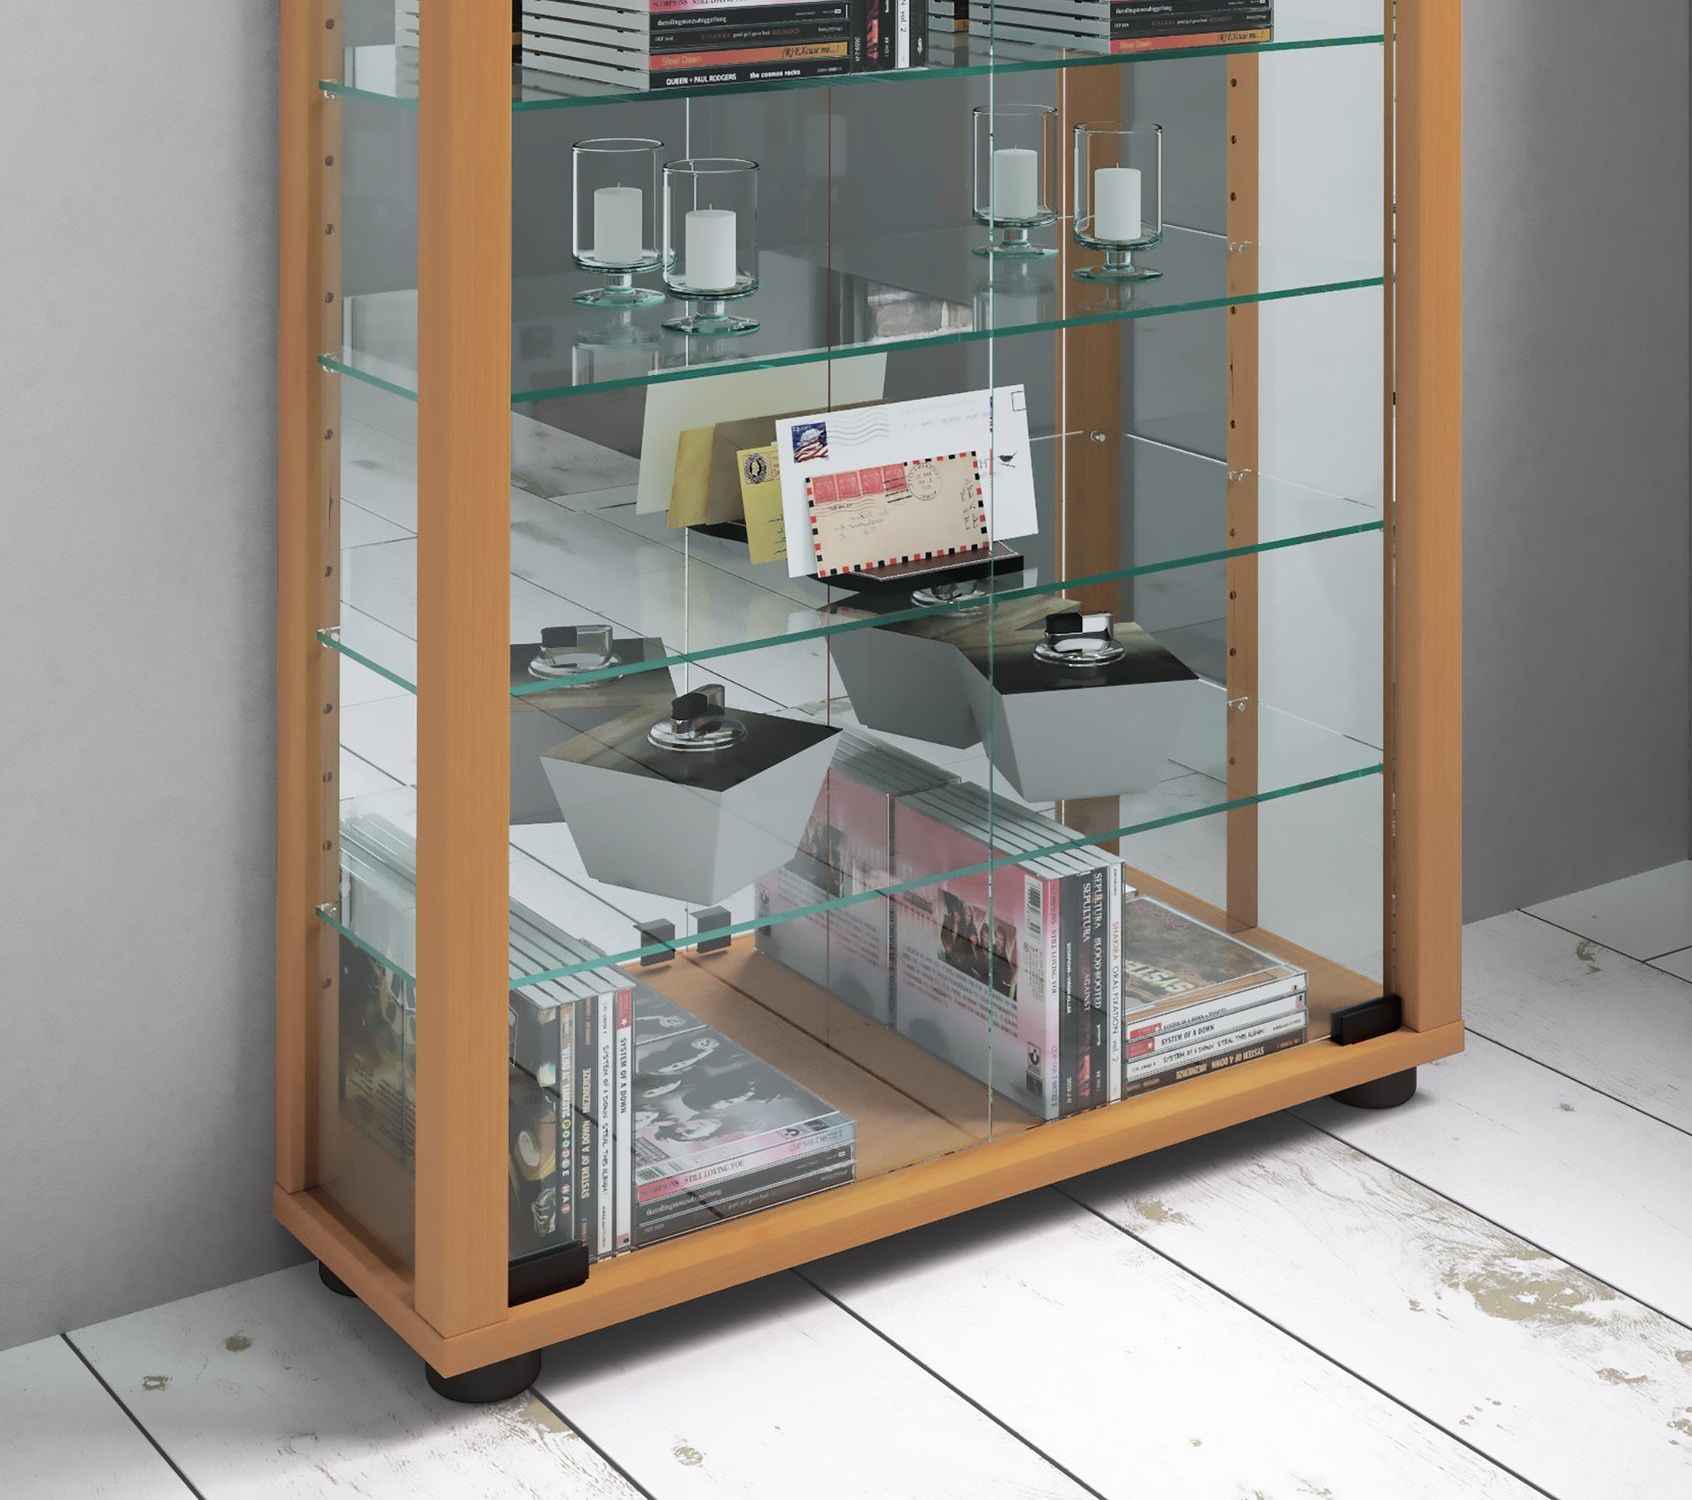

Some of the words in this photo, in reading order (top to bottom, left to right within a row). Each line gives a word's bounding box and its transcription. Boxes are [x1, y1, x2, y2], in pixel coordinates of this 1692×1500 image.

[662, 56, 680, 66] Steel
[666, 77, 688, 87] QUEEN
[694, 75, 709, 85] PAUL
[709, 73, 737, 84] RODGERS
[750, 72, 760, 80] the
[761, 70, 783, 79] cosmos
[785, 69, 801, 77] rocks
[1094, 872, 1103, 929] SEPULTURA
[1083, 882, 1091, 943] SEPULTURA
[1161, 1031, 1183, 1046] SYSTEM
[1184, 1029, 1192, 1039] OF
[1198, 1024, 1215, 1035] DOWN
[602, 1078, 609, 1086] OF
[620, 1069, 627, 1078] OF
[582, 1119, 591, 1146] DOWN
[582, 1154, 590, 1166] OF
[704, 1165, 730, 1181] LOVING
[730, 1160, 745, 1172] YOU
[581, 1166, 590, 1199] SYSTEM
